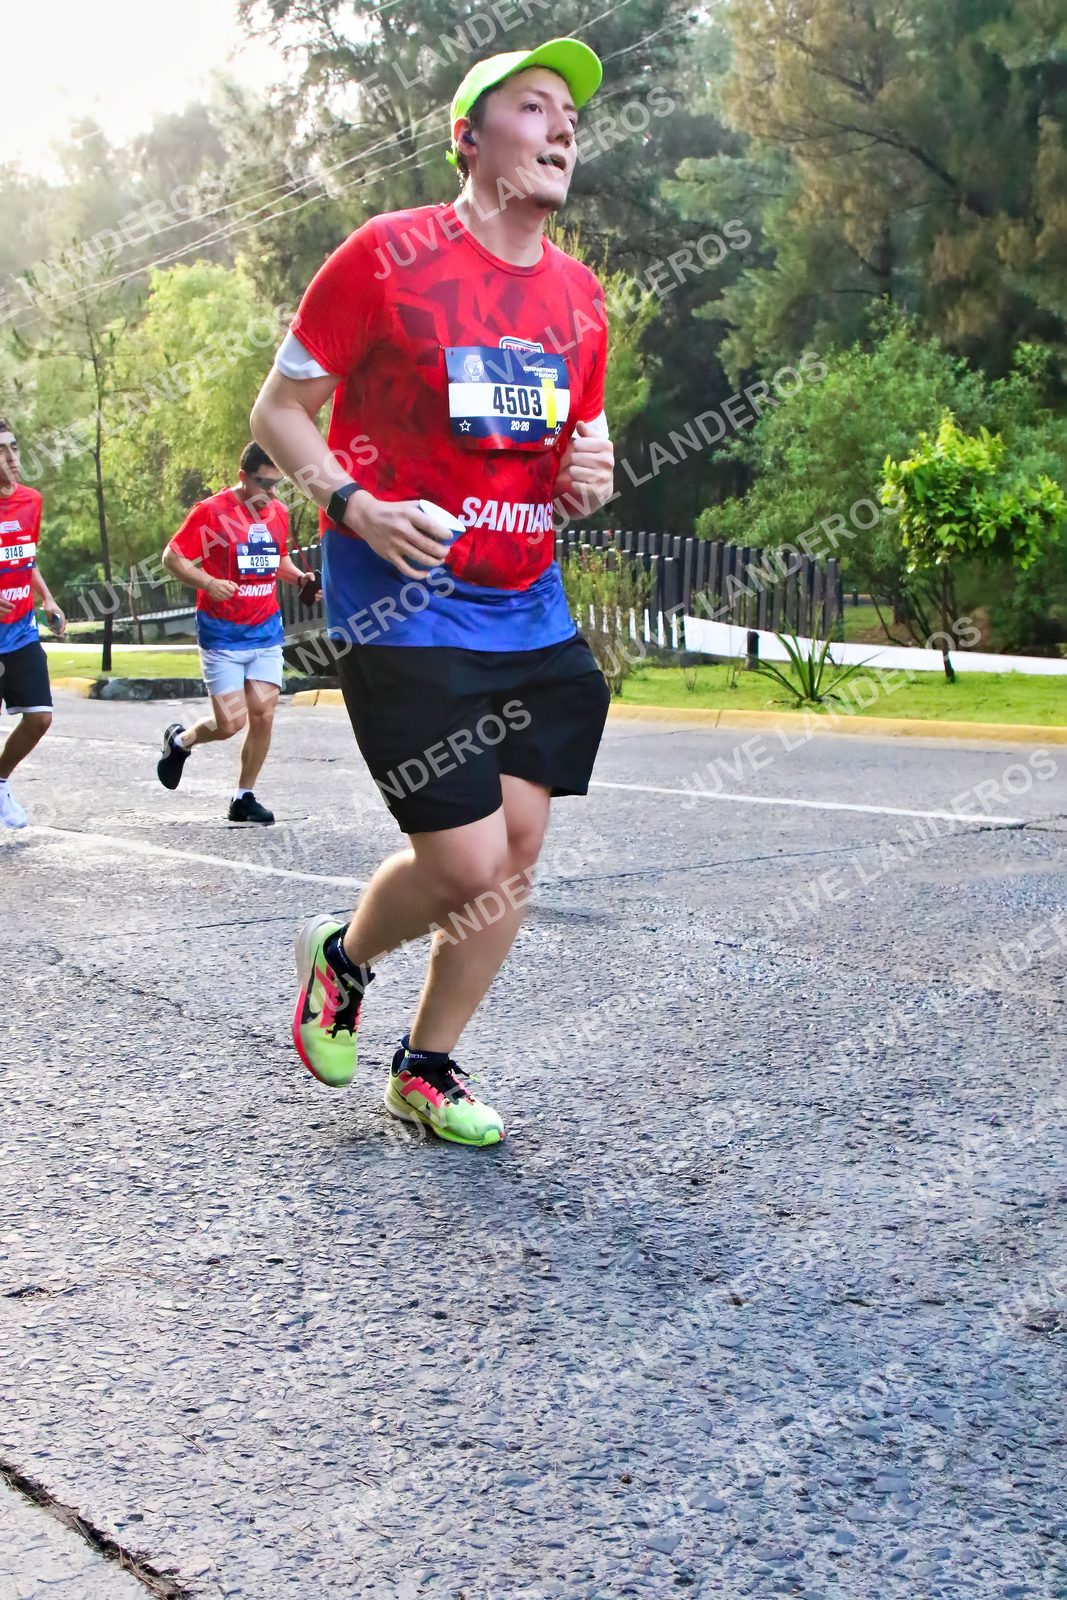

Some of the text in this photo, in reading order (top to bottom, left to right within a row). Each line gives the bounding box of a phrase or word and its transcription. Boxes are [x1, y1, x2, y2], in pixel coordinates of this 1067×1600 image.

[492, 386, 542, 417] 4503
[457, 496, 553, 534] SANTIAG
[4, 546, 24, 559] 3148
[249, 556, 270, 567] 4205
